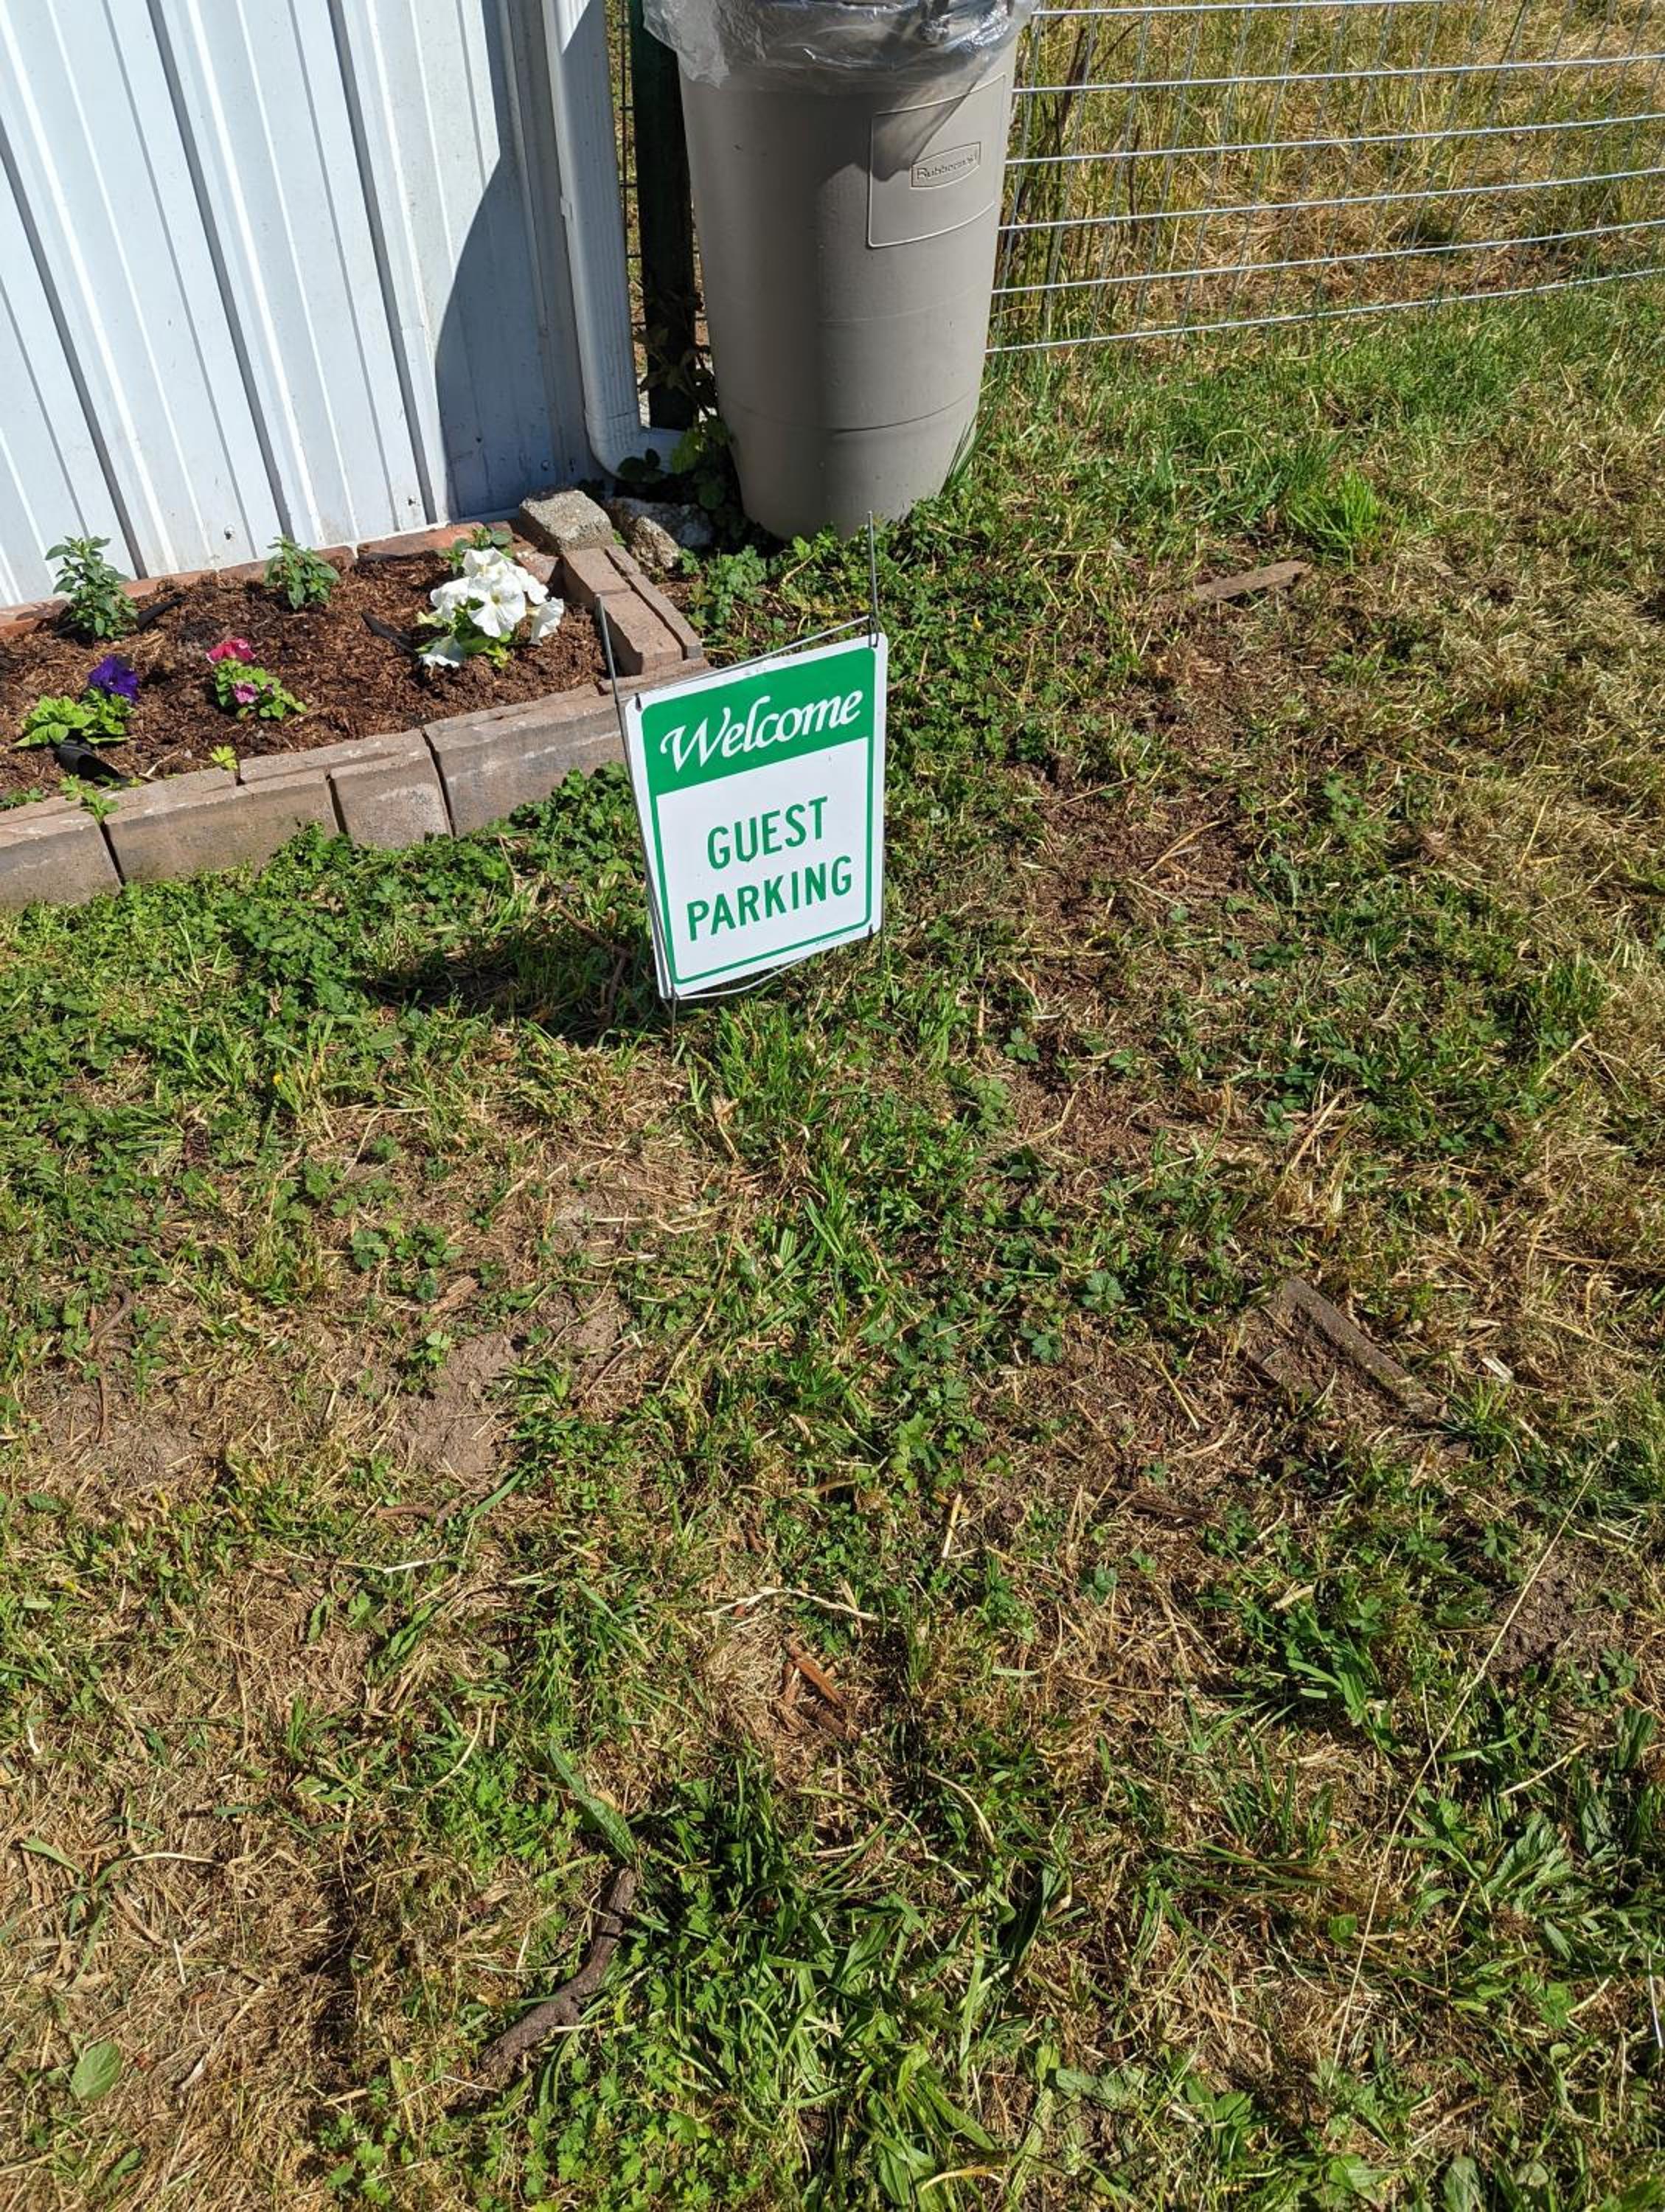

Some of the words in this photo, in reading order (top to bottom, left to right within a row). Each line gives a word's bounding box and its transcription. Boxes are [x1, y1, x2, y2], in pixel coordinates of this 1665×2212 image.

[661, 690, 863, 772] Welcome
[707, 796, 827, 870] GUEST
[686, 855, 852, 942] PARKING
